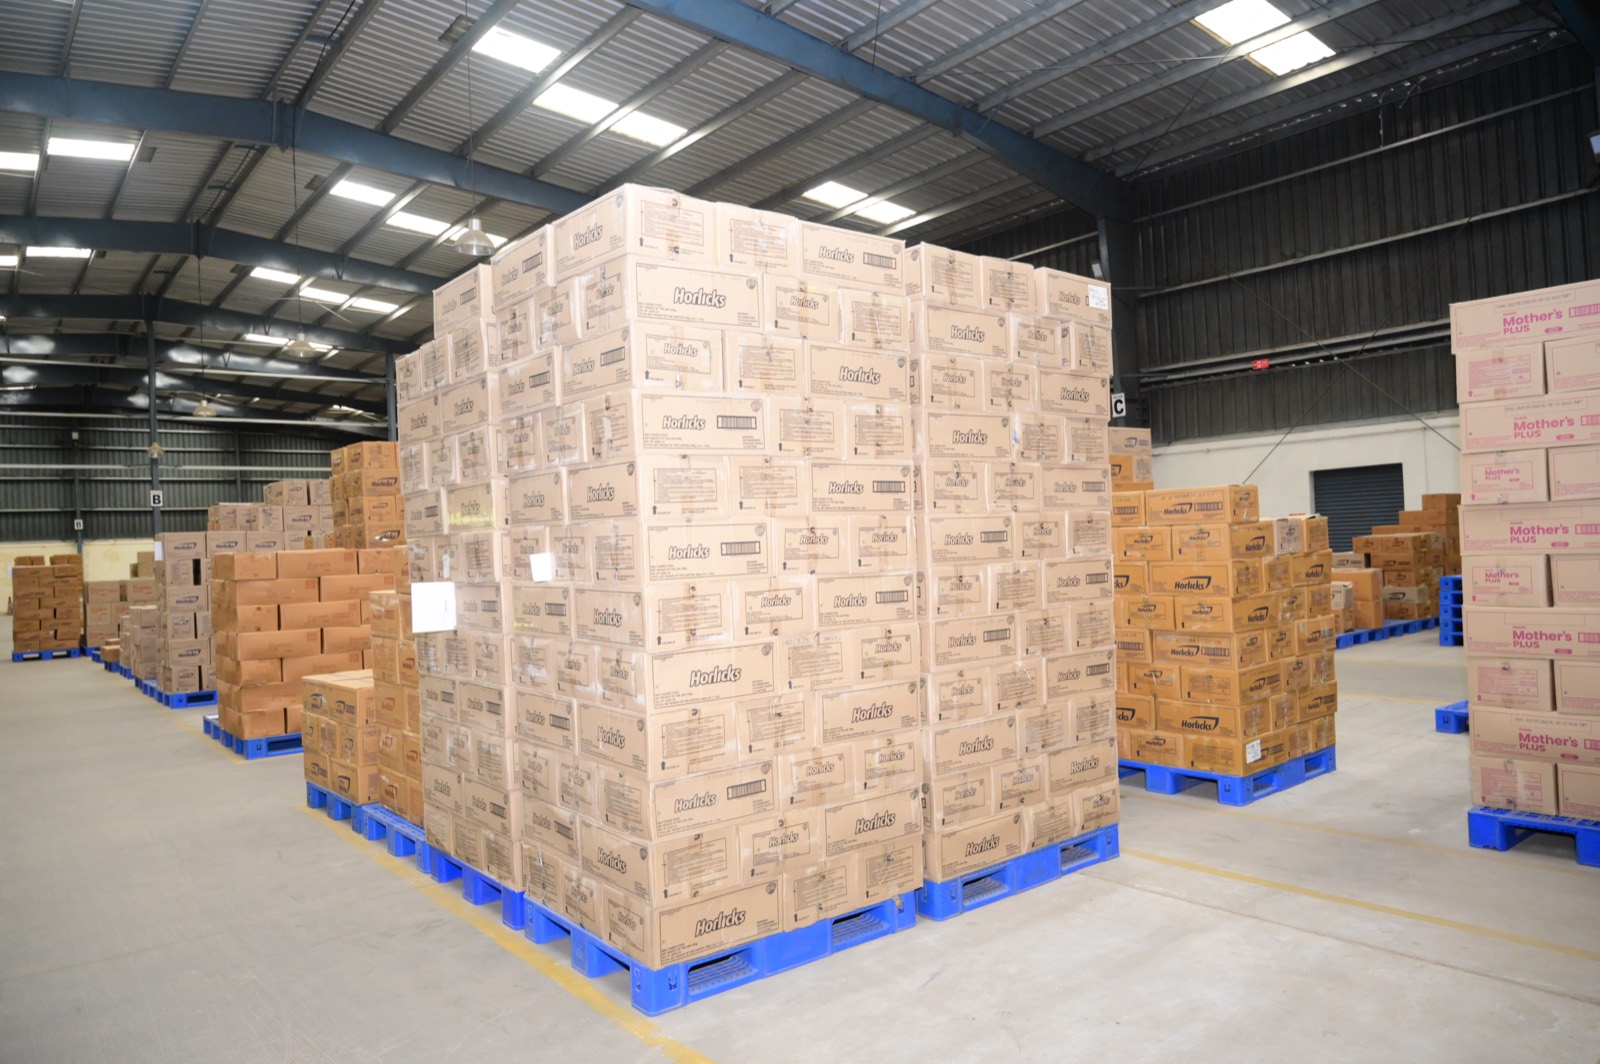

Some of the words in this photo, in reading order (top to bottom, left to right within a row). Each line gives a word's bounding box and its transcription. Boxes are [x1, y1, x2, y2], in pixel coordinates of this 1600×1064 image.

[573, 223, 603, 251] Horlicks
[819, 246, 854, 263] Horlicks
[673, 287, 726, 309] Horlicks
[790, 296, 818, 309] Horlicks
[1503, 309, 1563, 327] Mother's
[951, 325, 984, 342] Horlicks
[1504, 325, 1530, 335] PLUS
[663, 343, 698, 358] Horlicks
[839, 366, 880, 384] Horlicks
[1061, 387, 1089, 402] Horlicks
[1113, 398, 1124, 415] C
[662, 415, 706, 430] Horlicks
[1514, 417, 1574, 431] Mother's
[952, 430, 987, 445] Horlicks
[1514, 431, 1541, 439] PLUS
[587, 483, 615, 502] Horlicks
[828, 481, 864, 494] Horlicks
[152, 494, 161, 505] B
[1164, 505, 1187, 515] Horlicks
[1510, 524, 1569, 535] Mother's
[799, 534, 829, 545] Horlicks
[945, 533, 973, 545] Horlicks
[668, 545, 710, 560] Horlicks
[1057, 577, 1080, 588] Horlicks
[1175, 581, 1204, 590] Horlicks
[761, 596, 791, 608] Horlicks
[834, 594, 867, 608] Horlicks
[594, 608, 622, 627] Horlicks
[1513, 631, 1572, 641] Mother's
[875, 642, 901, 653] Horlicks
[1171, 648, 1194, 656] Horlicks
[690, 664, 741, 687] Horlicks
[1057, 669, 1080, 682] Horlicks
[851, 702, 893, 723] Horlicks
[1181, 720, 1212, 730] Horlicks
[597, 726, 625, 749] Horlicks
[1519, 733, 1578, 747] Mother's
[959, 736, 994, 756] Horlicks
[1520, 743, 1546, 752] PLUS
[878, 751, 905, 763] Horlicks
[1071, 755, 1099, 775] Horlicks
[954, 787, 977, 800] Horlicks
[674, 792, 716, 812] Horlicks
[855, 811, 896, 834] Horlicks
[769, 831, 798, 848] Horlicks
[965, 834, 1000, 857] Horlicks
[598, 847, 627, 874] Horlicks
[695, 908, 746, 937] Horlicks
